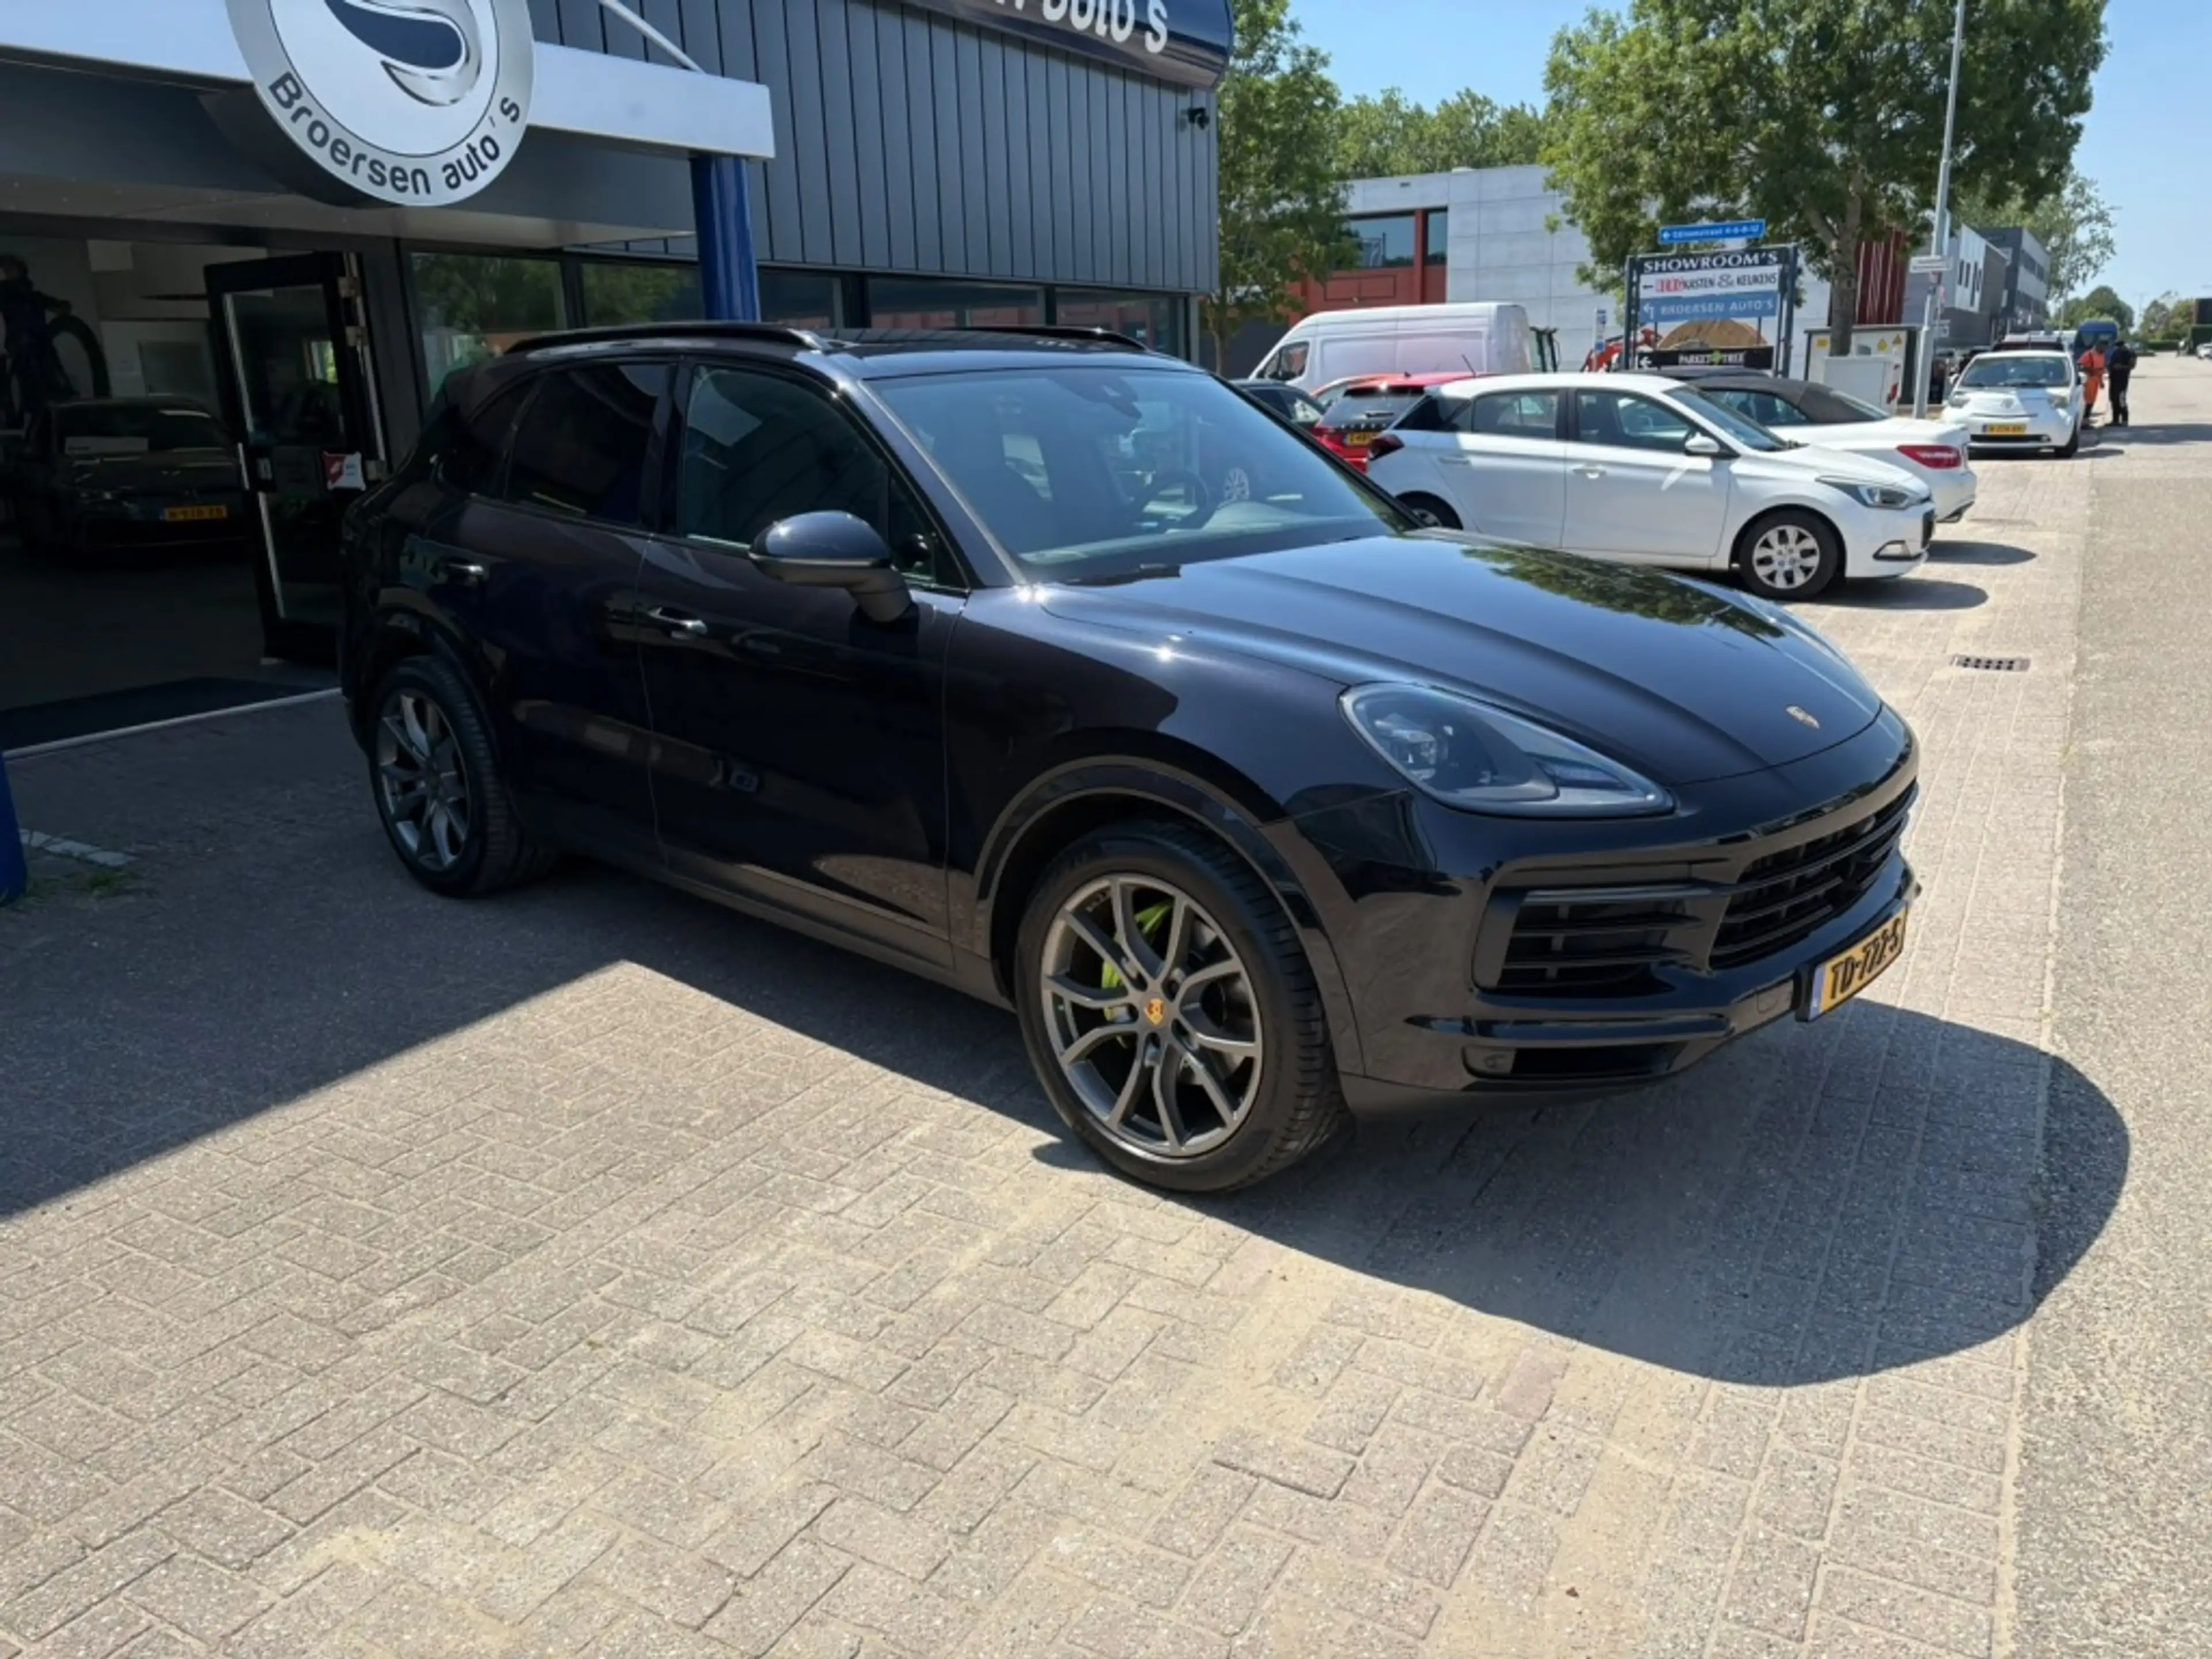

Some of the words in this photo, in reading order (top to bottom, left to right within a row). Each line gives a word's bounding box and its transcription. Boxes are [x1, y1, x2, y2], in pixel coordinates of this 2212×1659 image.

[269, 72, 430, 194] Broersen
[445, 97, 520, 190] auto's
[1643, 251, 1778, 273] SHOWROOM'S
